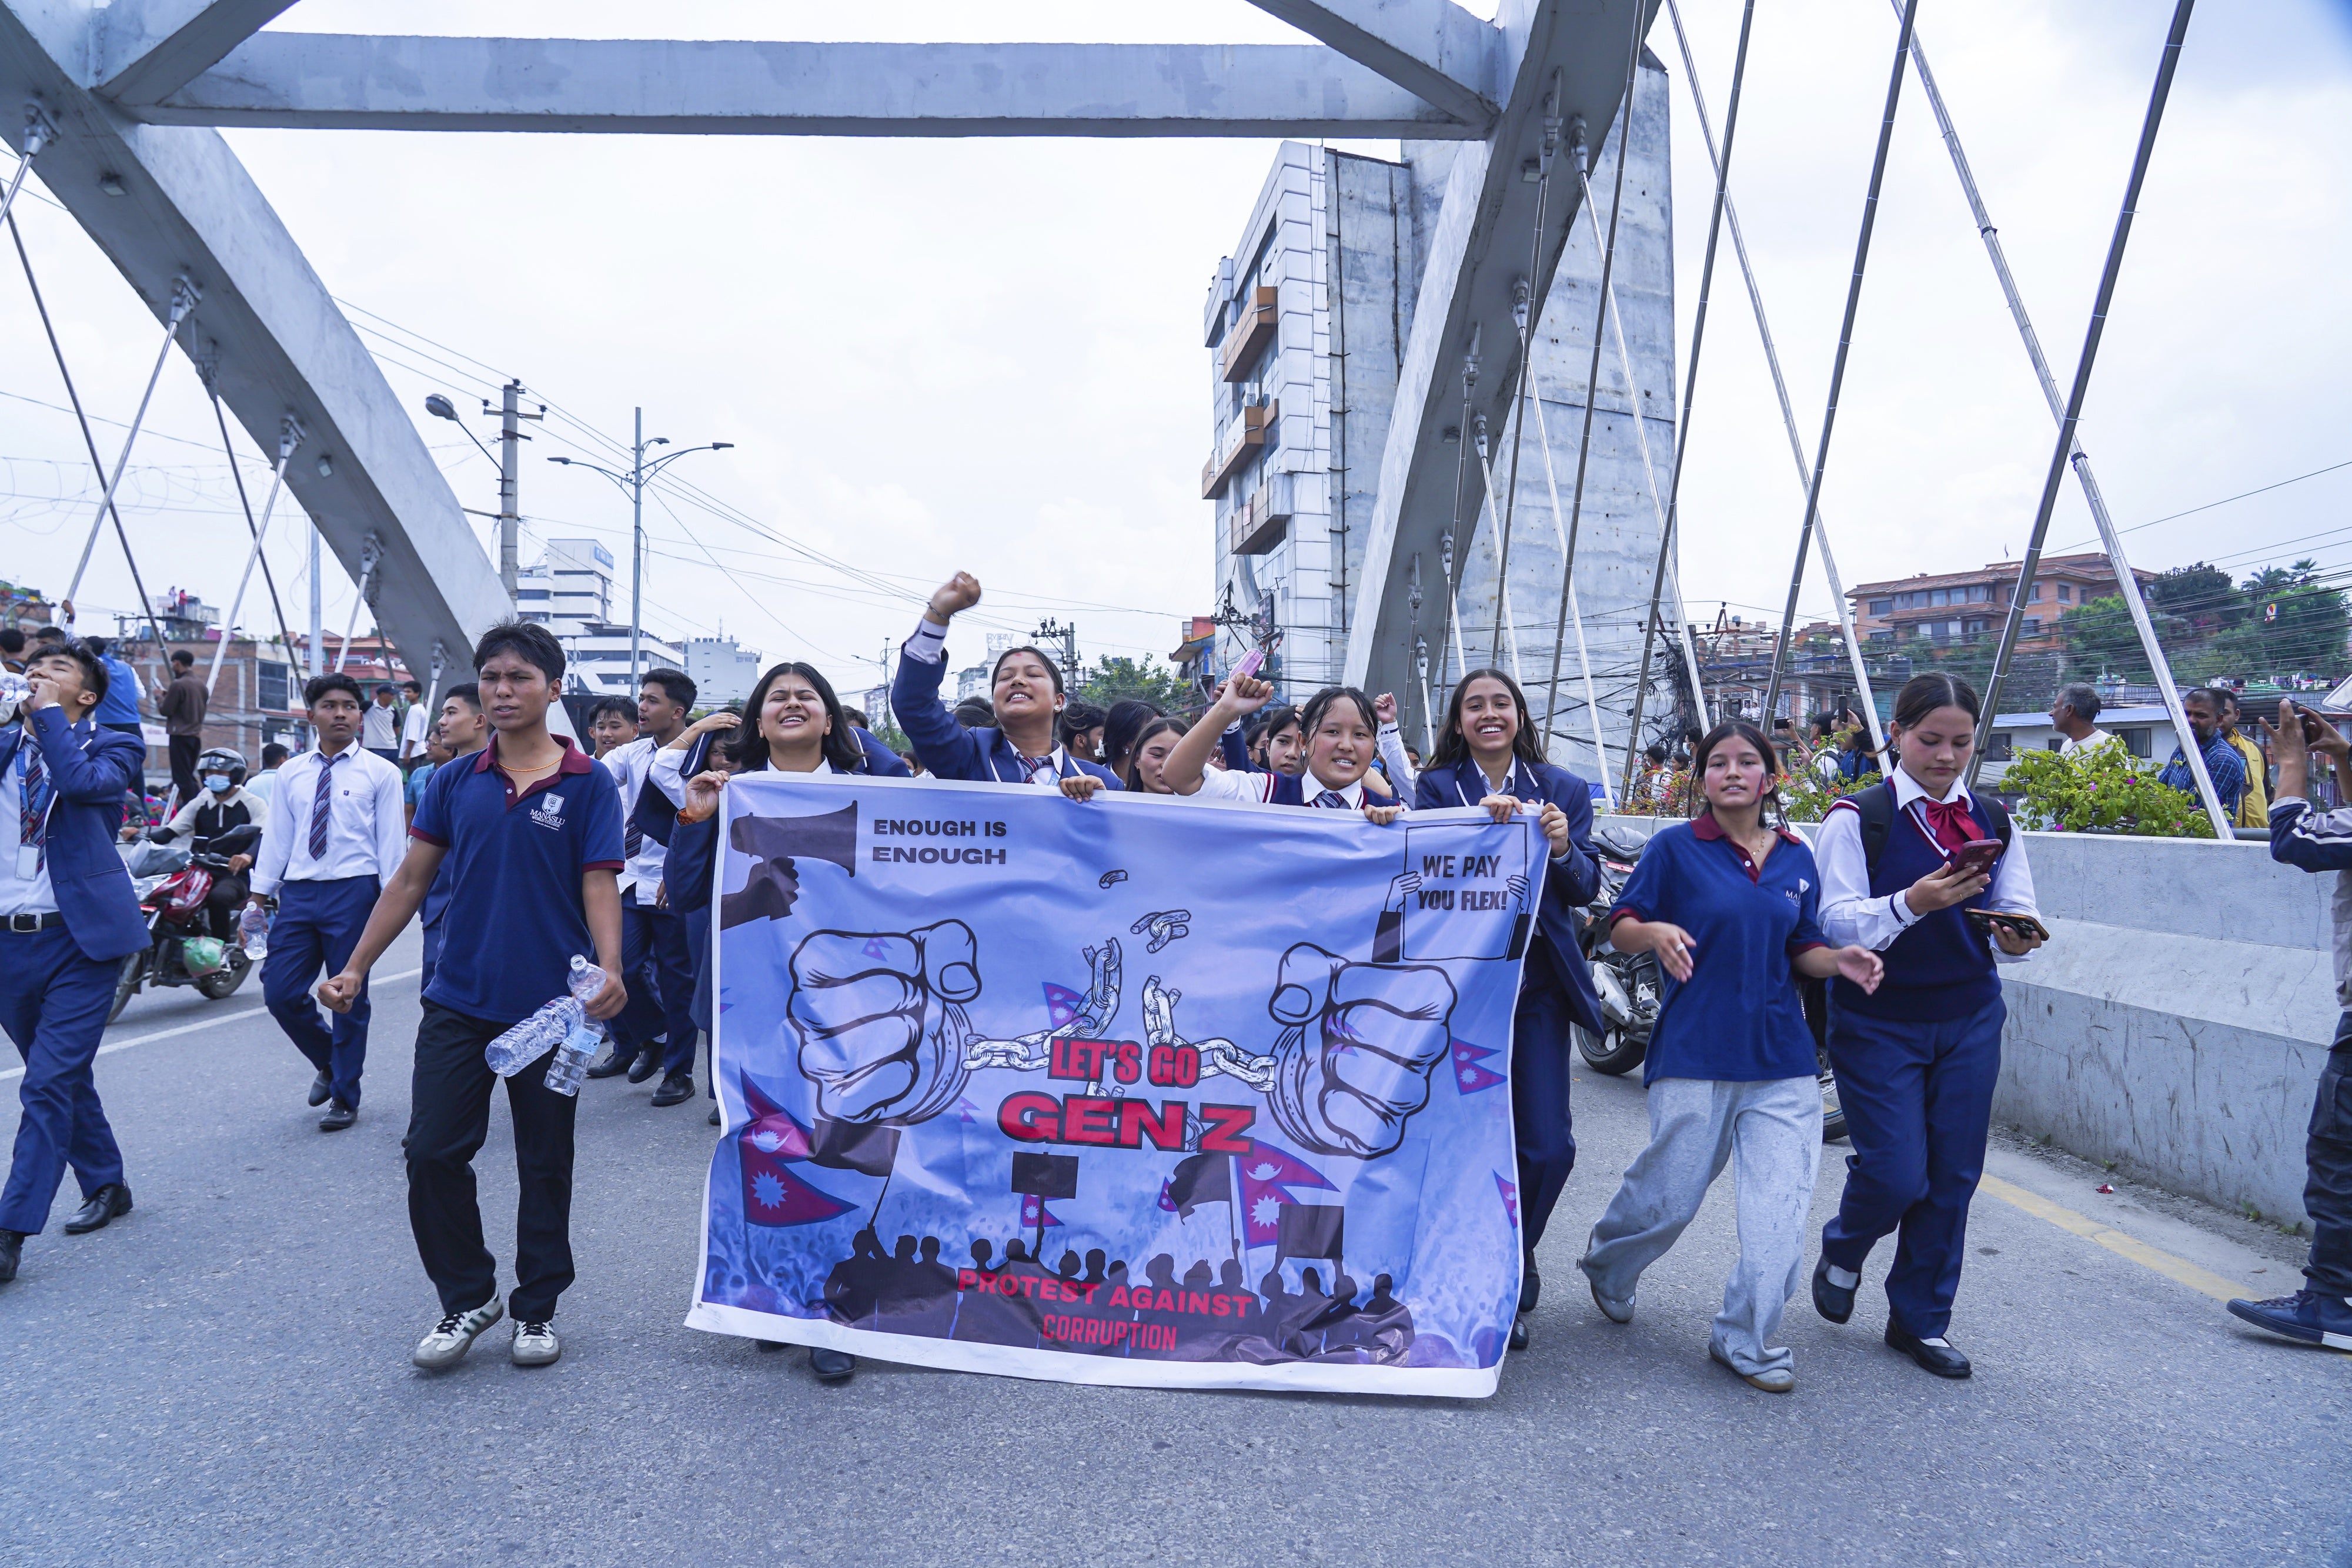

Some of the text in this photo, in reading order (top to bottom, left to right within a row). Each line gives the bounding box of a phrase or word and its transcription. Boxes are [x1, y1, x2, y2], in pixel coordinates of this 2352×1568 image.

[529, 808, 565, 825] MANASLU
[544, 820, 560, 828] COLLEGE
[873, 819, 1007, 837] ENOUGH IS
[872, 846, 1007, 865] ENOUGH
[1423, 855, 1501, 878] WE PAY
[1418, 890, 1508, 911] YOU FLEX!
[1050, 1038, 1200, 1086] LET'S GO
[1000, 1093, 1254, 1155] GEN Z
[958, 1269, 1253, 1318] PROTEST AGAINST
[1043, 1314, 1177, 1351] CORRUPTION
